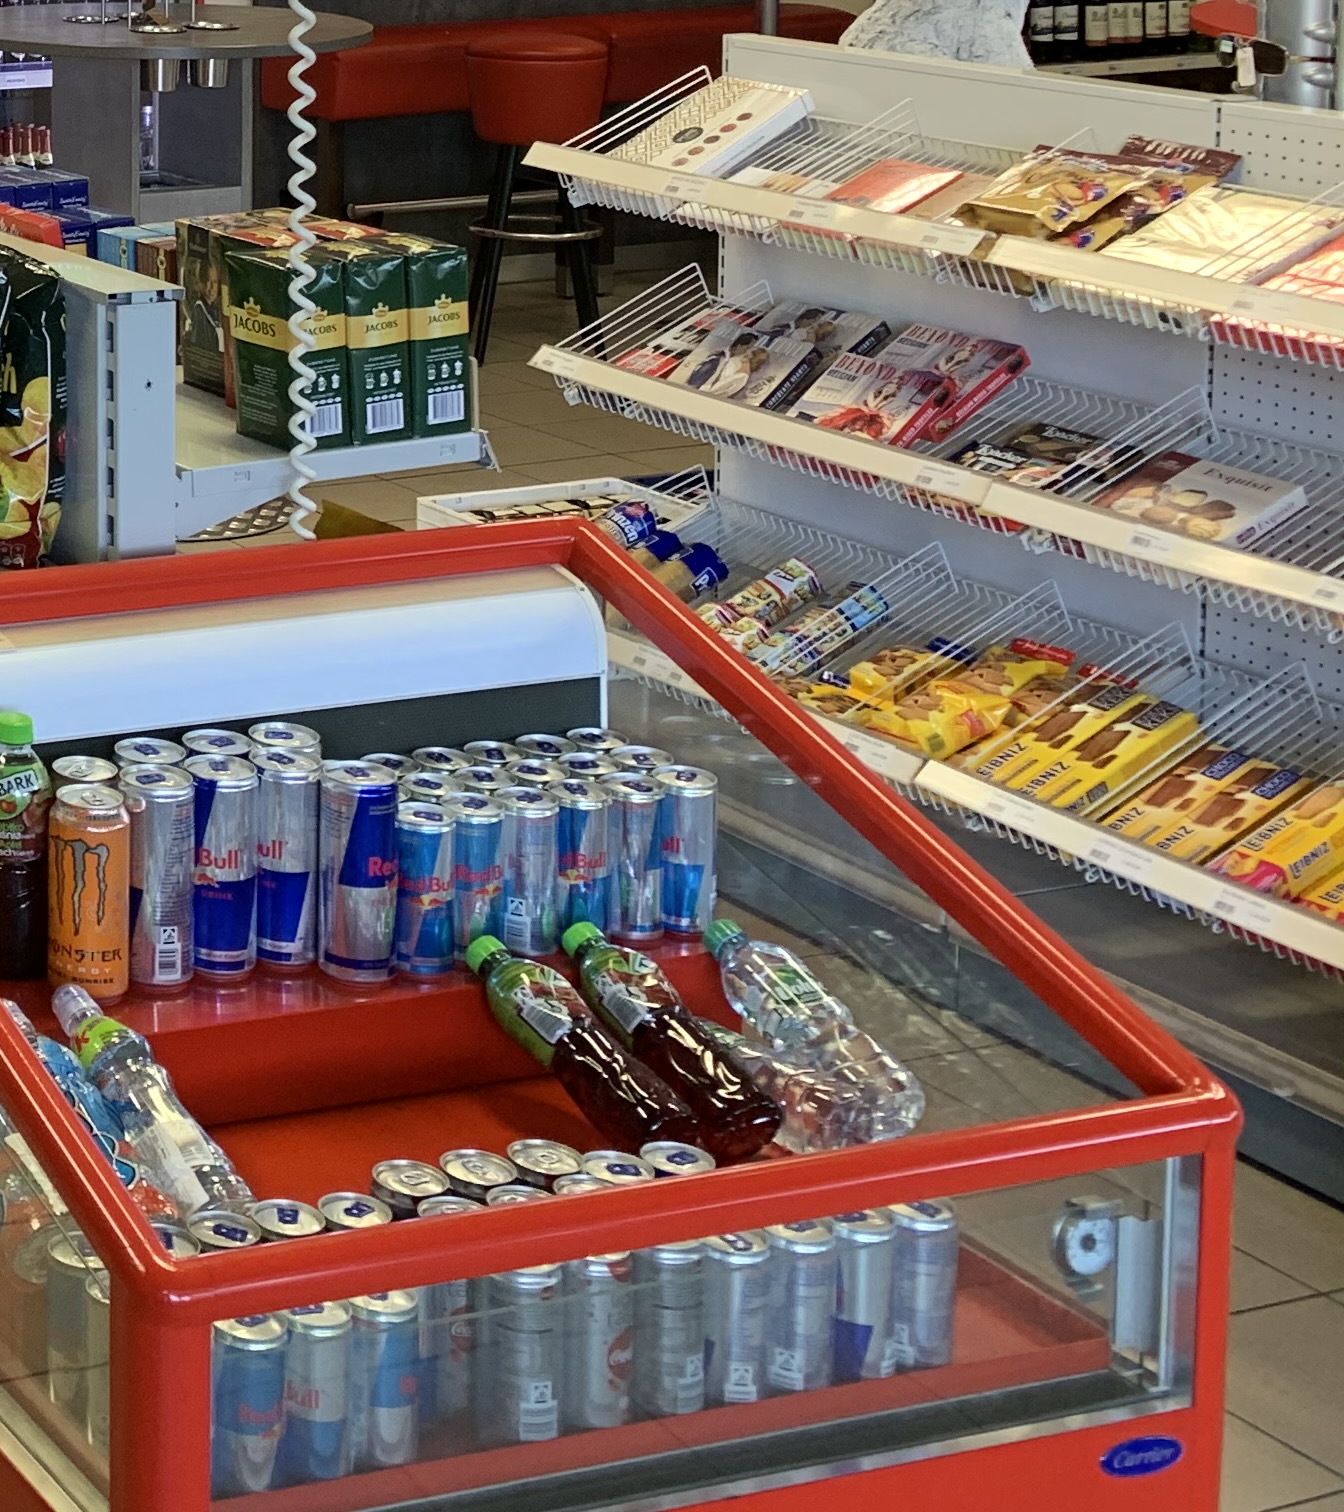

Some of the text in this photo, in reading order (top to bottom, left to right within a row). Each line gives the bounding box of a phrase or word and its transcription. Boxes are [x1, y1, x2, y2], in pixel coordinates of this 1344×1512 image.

[234, 313, 276, 338] JACOBS
[365, 318, 399, 335] JACOBS
[427, 311, 461, 325] JACOBS
[906, 324, 969, 349] BEYOND
[834, 351, 895, 381] BEYOND
[1202, 467, 1272, 493] Exquisit
[975, 741, 1028, 777] EIBNIZ
[1021, 760, 1072, 797] EIBNIZ
[1111, 806, 1145, 832] BNIZ
[1156, 824, 1195, 852] BNIZ
[1242, 816, 1294, 853] LEIBNIZ
[198, 847, 240, 870] Bull
[1288, 840, 1330, 881] LEIBNIZ
[1318, 878, 1344, 906] LEIB
[53, 944, 123, 963] ONSTER
